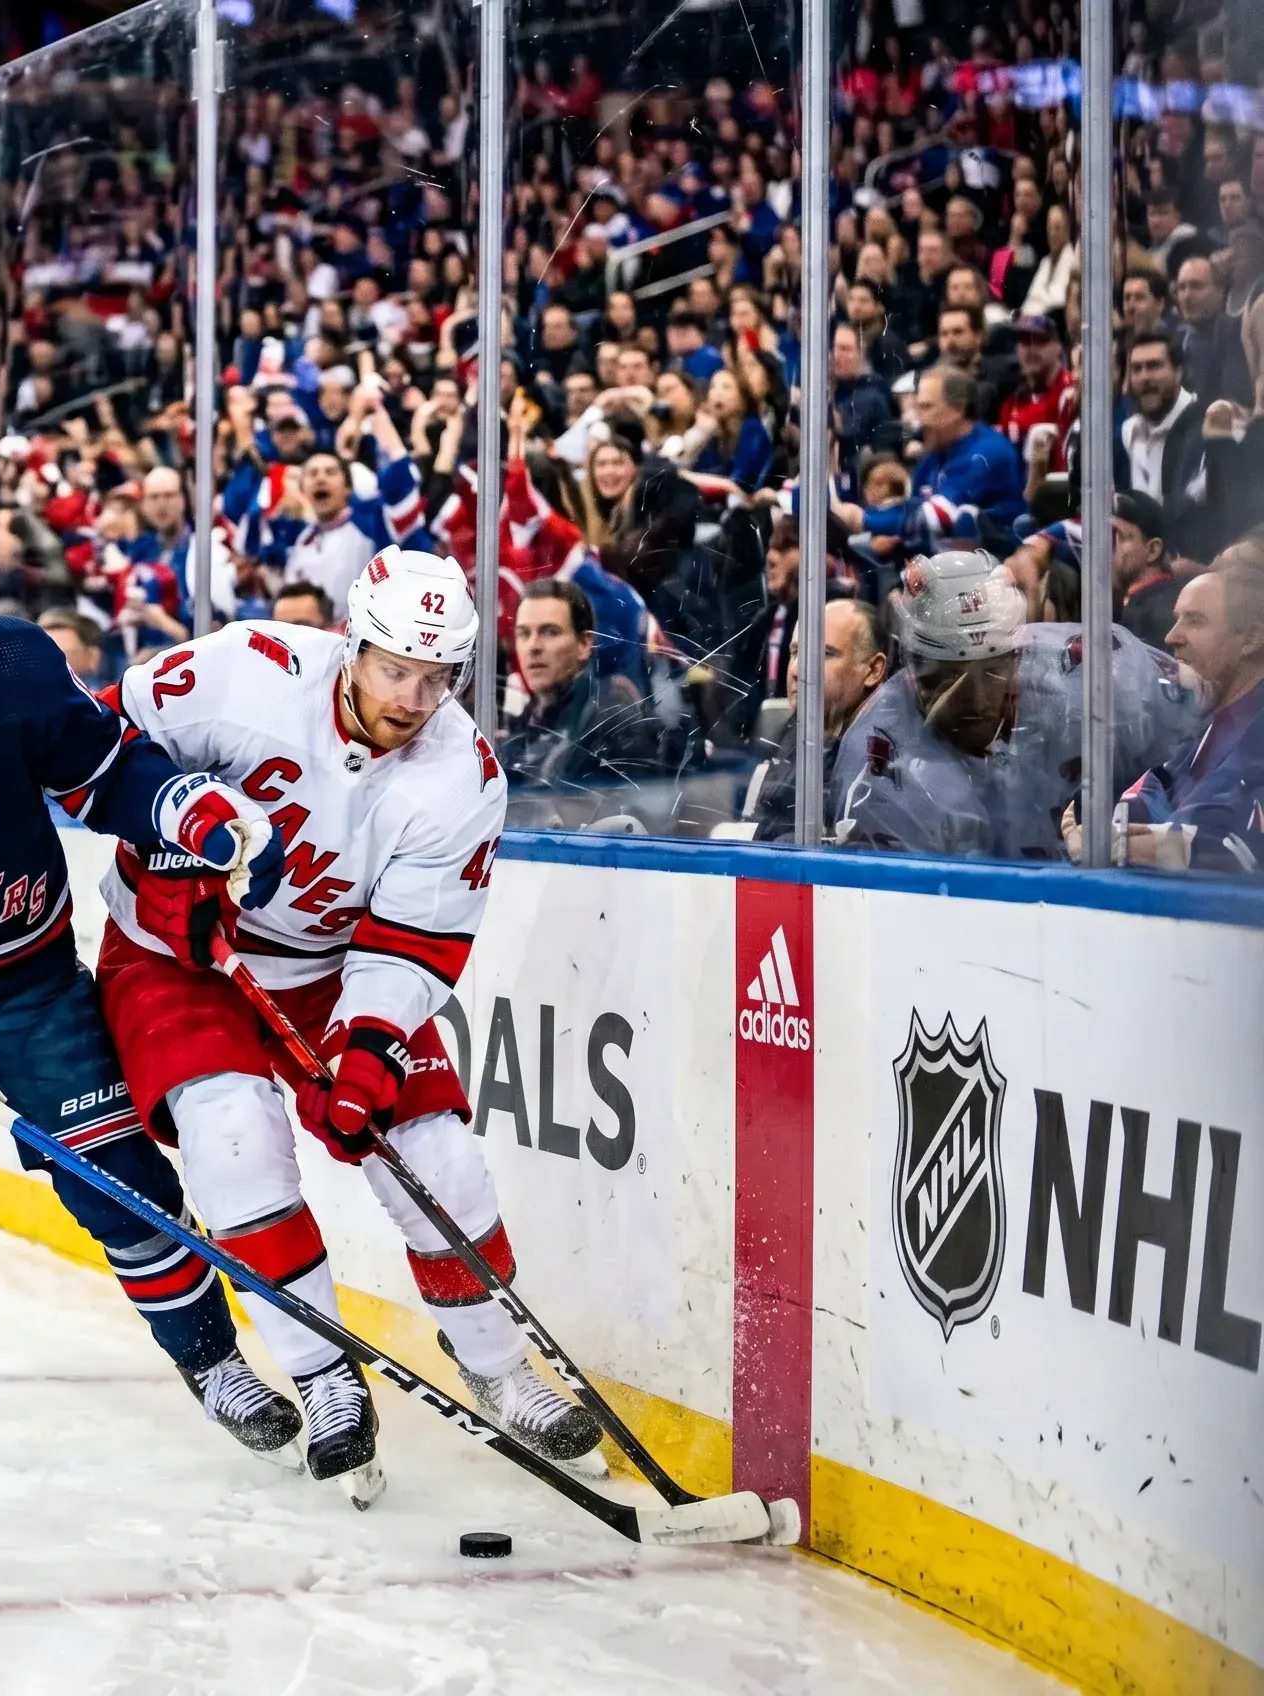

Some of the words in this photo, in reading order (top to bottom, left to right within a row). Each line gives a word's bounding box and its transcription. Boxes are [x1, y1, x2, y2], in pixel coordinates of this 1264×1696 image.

[420, 591, 445, 615] 42
[153, 650, 196, 711] 42
[241, 756, 369, 936] CANES
[739, 1002, 811, 1051] adidas
[407, 1057, 449, 1075] CM
[918, 1106, 980, 1251] NHL
[1022, 1087, 1263, 1374] NHL
